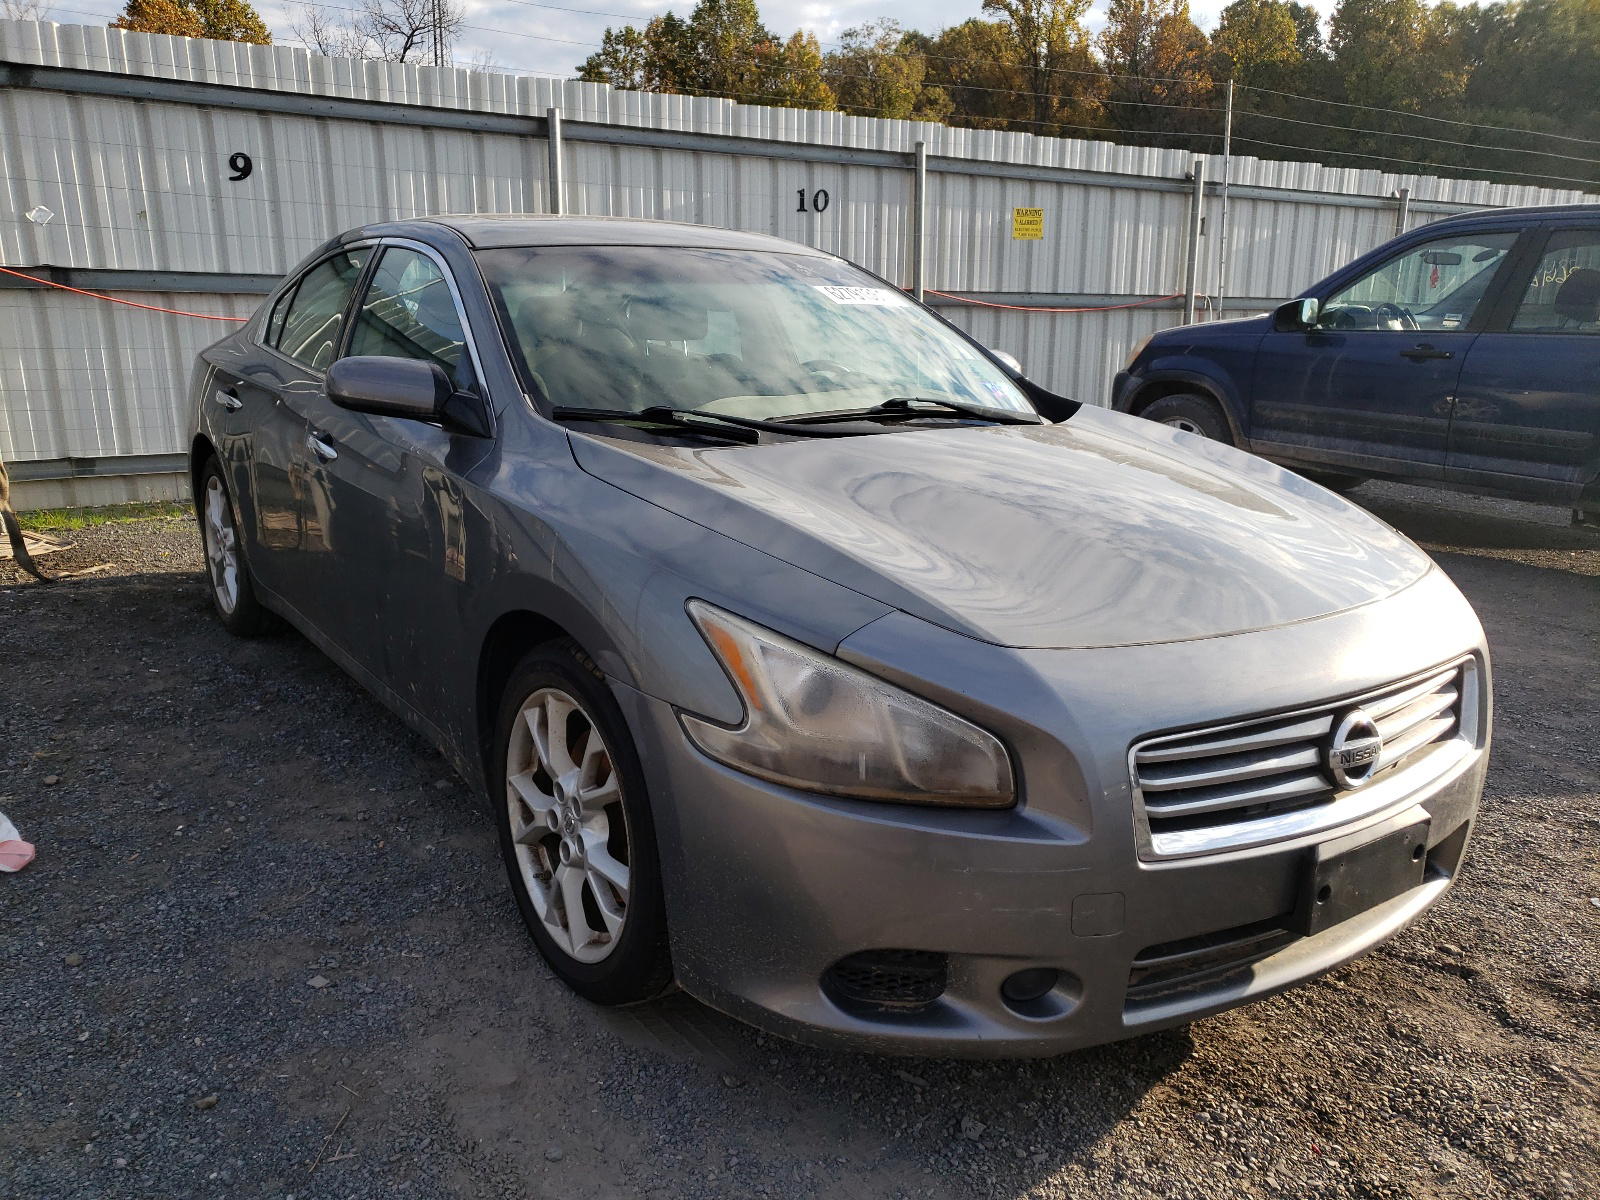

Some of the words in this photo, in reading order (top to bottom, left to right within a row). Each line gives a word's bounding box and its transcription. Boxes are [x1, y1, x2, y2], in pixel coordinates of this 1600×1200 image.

[229, 152, 253, 181] 9
[797, 188, 830, 213] 10
[1015, 208, 1042, 217] WARNING
[1340, 743, 1381, 766] NISSA
